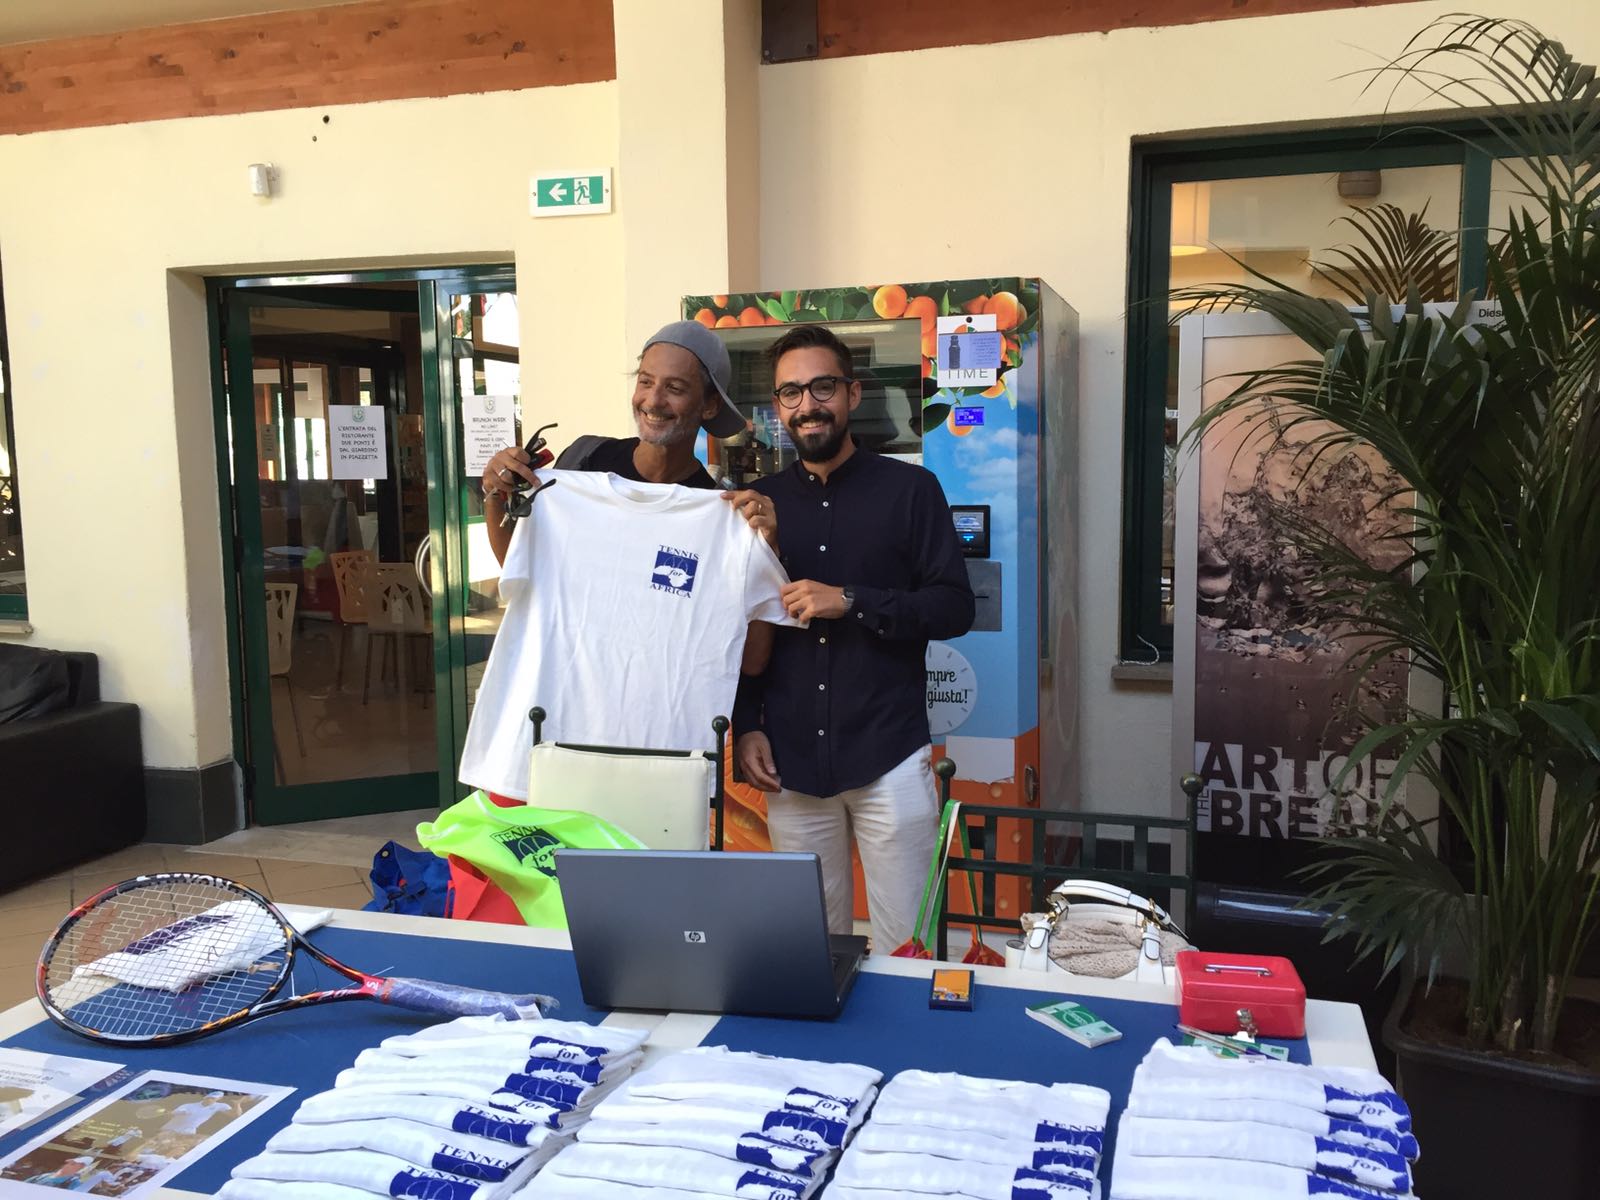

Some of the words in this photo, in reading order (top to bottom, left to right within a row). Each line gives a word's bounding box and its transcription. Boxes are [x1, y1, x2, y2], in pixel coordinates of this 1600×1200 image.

[659, 544, 699, 560] TENNIS
[668, 569, 683, 577] for
[650, 583, 691, 599] AFRICA
[926, 669, 957, 688] mpre
[927, 689, 968, 709] giusta!
[1200, 742, 1320, 796] ART
[494, 825, 541, 843] TENNI
[556, 1048, 579, 1060] for
[1357, 1103, 1386, 1116] for
[440, 1143, 511, 1169] TENNIS
[1348, 1159, 1380, 1172] for
[754, 1168, 808, 1186] TENN
